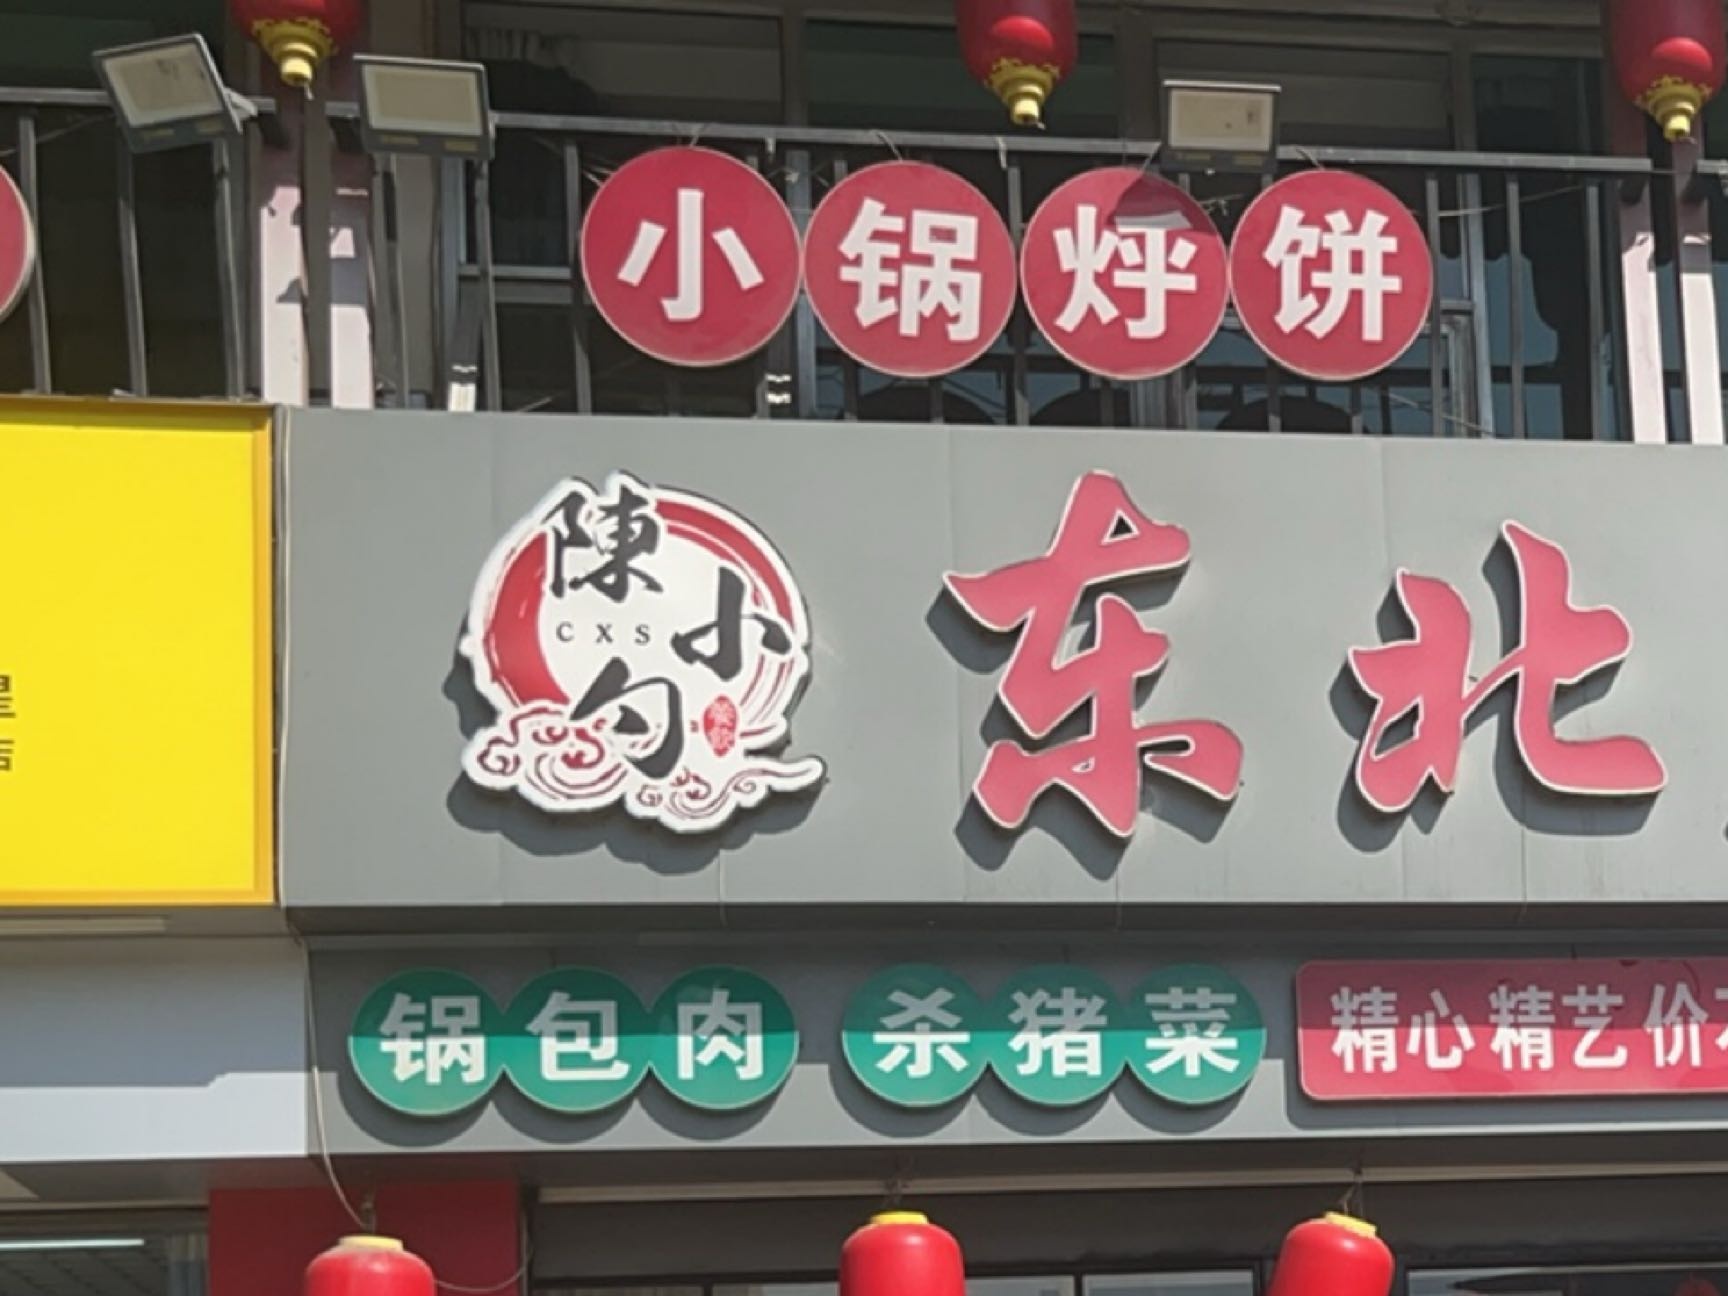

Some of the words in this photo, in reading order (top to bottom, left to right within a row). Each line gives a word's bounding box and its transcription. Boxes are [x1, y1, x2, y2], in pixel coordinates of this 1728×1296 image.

[617, 188, 1400, 342] 小锅烀饼
[556, 620, 651, 645] CXS
[379, 988, 766, 1087] 锅包肉
[872, 986, 1240, 1080] 杀猪菜
